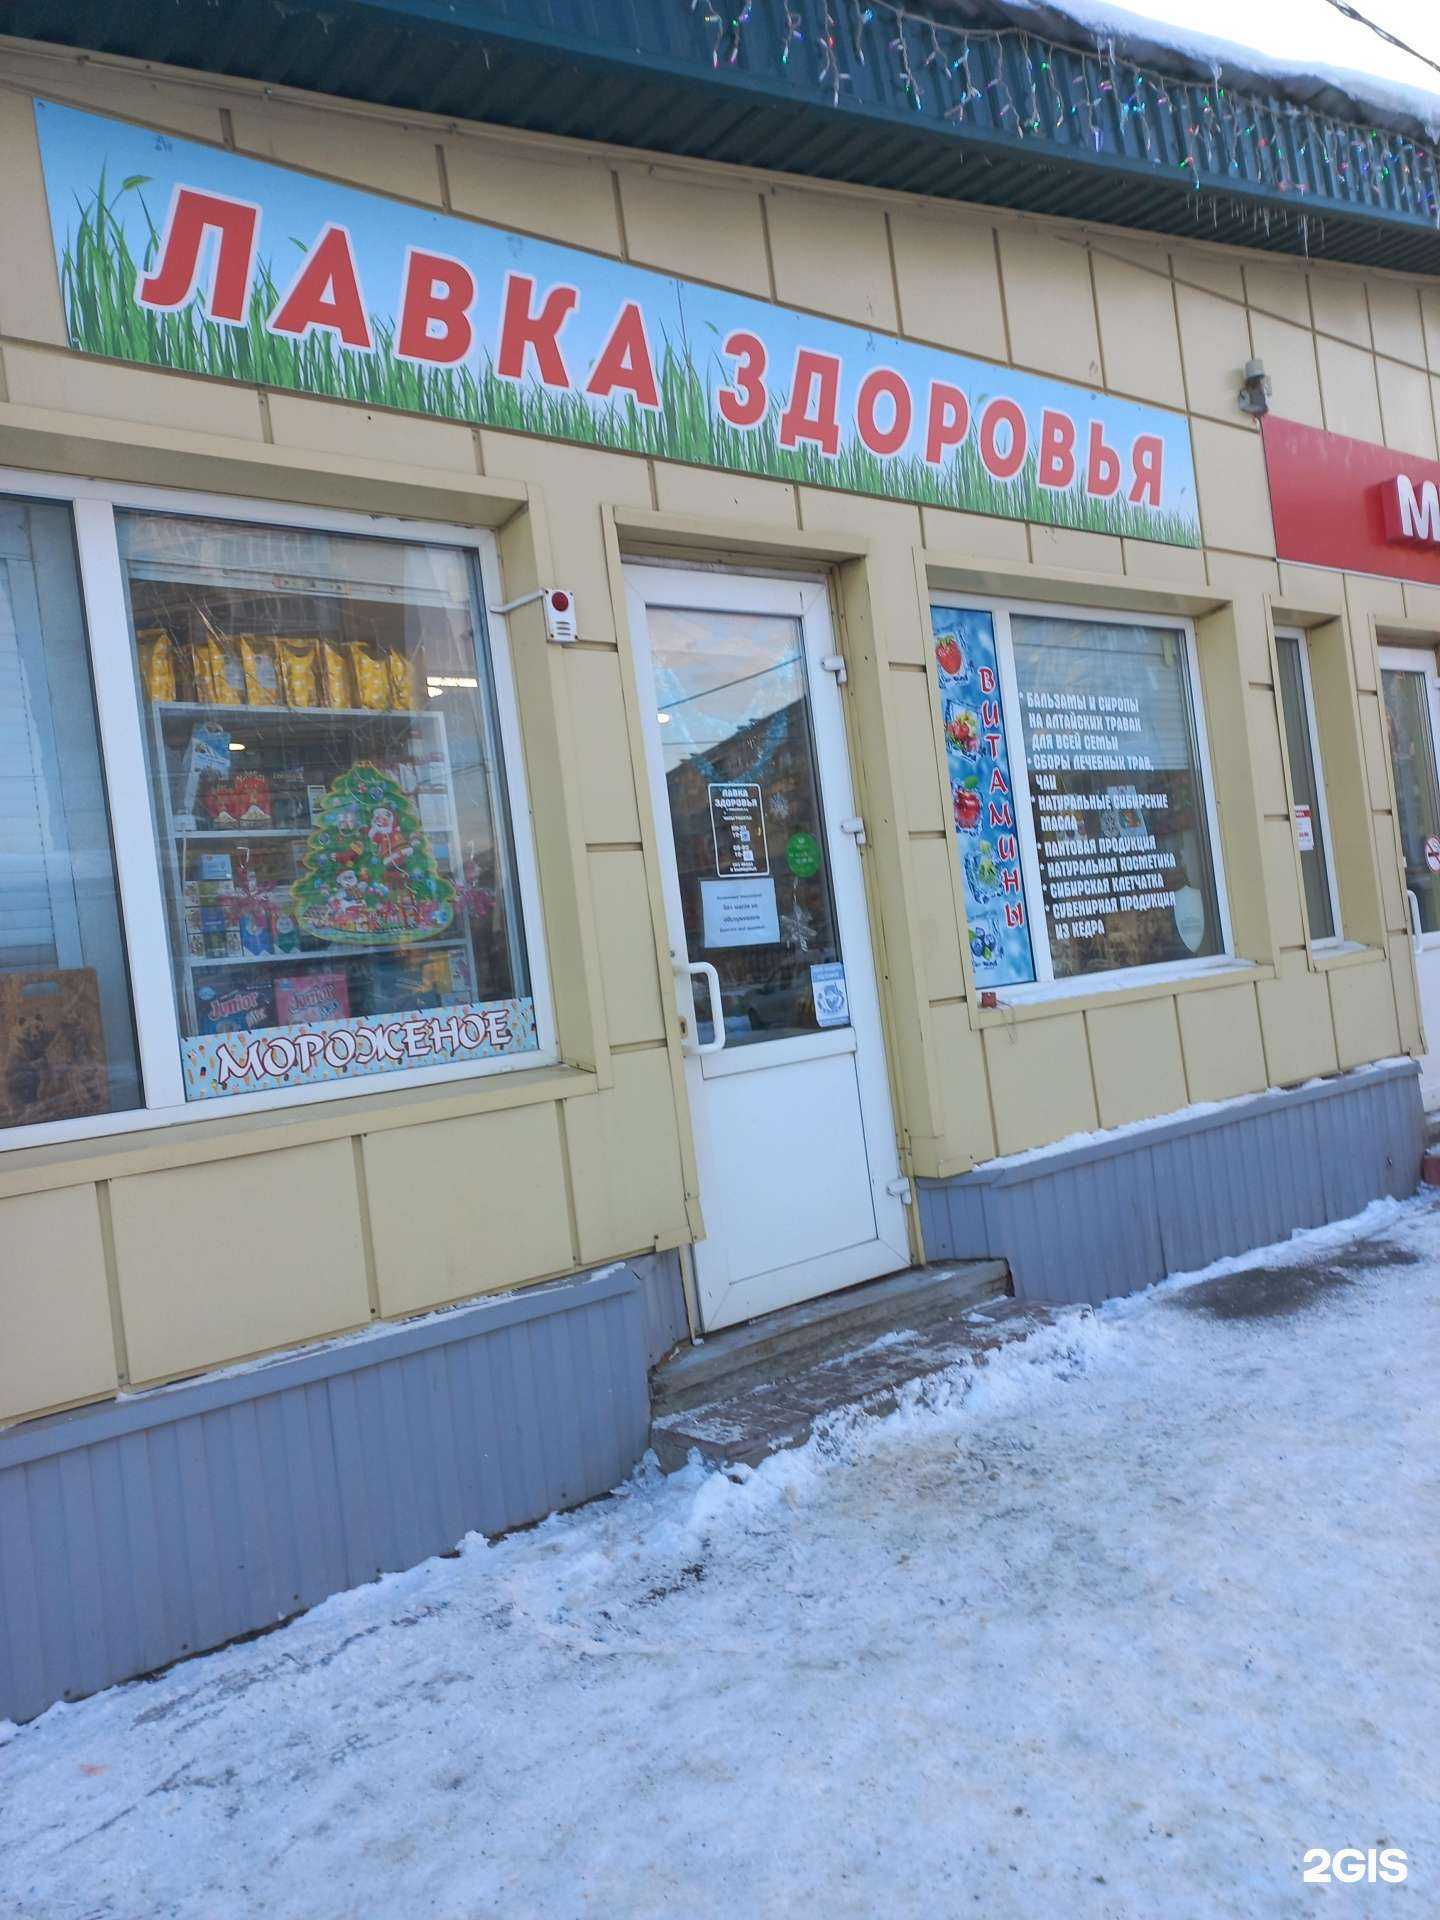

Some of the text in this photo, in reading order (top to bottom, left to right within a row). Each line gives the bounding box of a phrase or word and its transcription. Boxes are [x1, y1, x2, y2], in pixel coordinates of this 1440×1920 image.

[139, 187, 1163, 507] ЛАВКА ЗДОРОВЬЯ
[1026, 691, 1139, 713] БАЛЬЗАМЫ И СИРОПЫ
[1029, 712, 1142, 732] НА АЛТАЙСКИХ ТРАВАХ
[1032, 732, 1119, 751] ДЛЯ ВСЕЙ СЕМЬИ
[1033, 754, 1154, 772] СБОРЫ ЛЕЧЕБНЫХ ТРАВ,
[714, 799, 758, 808] ЗДОРОВЬЯ
[978, 668, 1024, 928] ВИТАМИНЫ
[1038, 793, 1169, 811] НАТУРАЛЬНЫЕ СИБИРСКИЕ
[1040, 815, 1078, 831] МАСЛА
[1044, 835, 1157, 857] ПАНТОВАЯ ПРОДУКЦИЯ
[1047, 853, 1176, 878] НАТУРАЛЬНАЯ КОСМЕТИКА
[1050, 873, 1164, 898] СИБИРСКАЯ КЛЕТЧАТКА
[1052, 891, 1176, 919] СУВЕНИРНАЯ ПРОДУКЦИЯ
[1055, 919, 1105, 940] ИЗ КЕДРА
[215, 1009, 514, 1086] МОРОЖЕНОЕ
